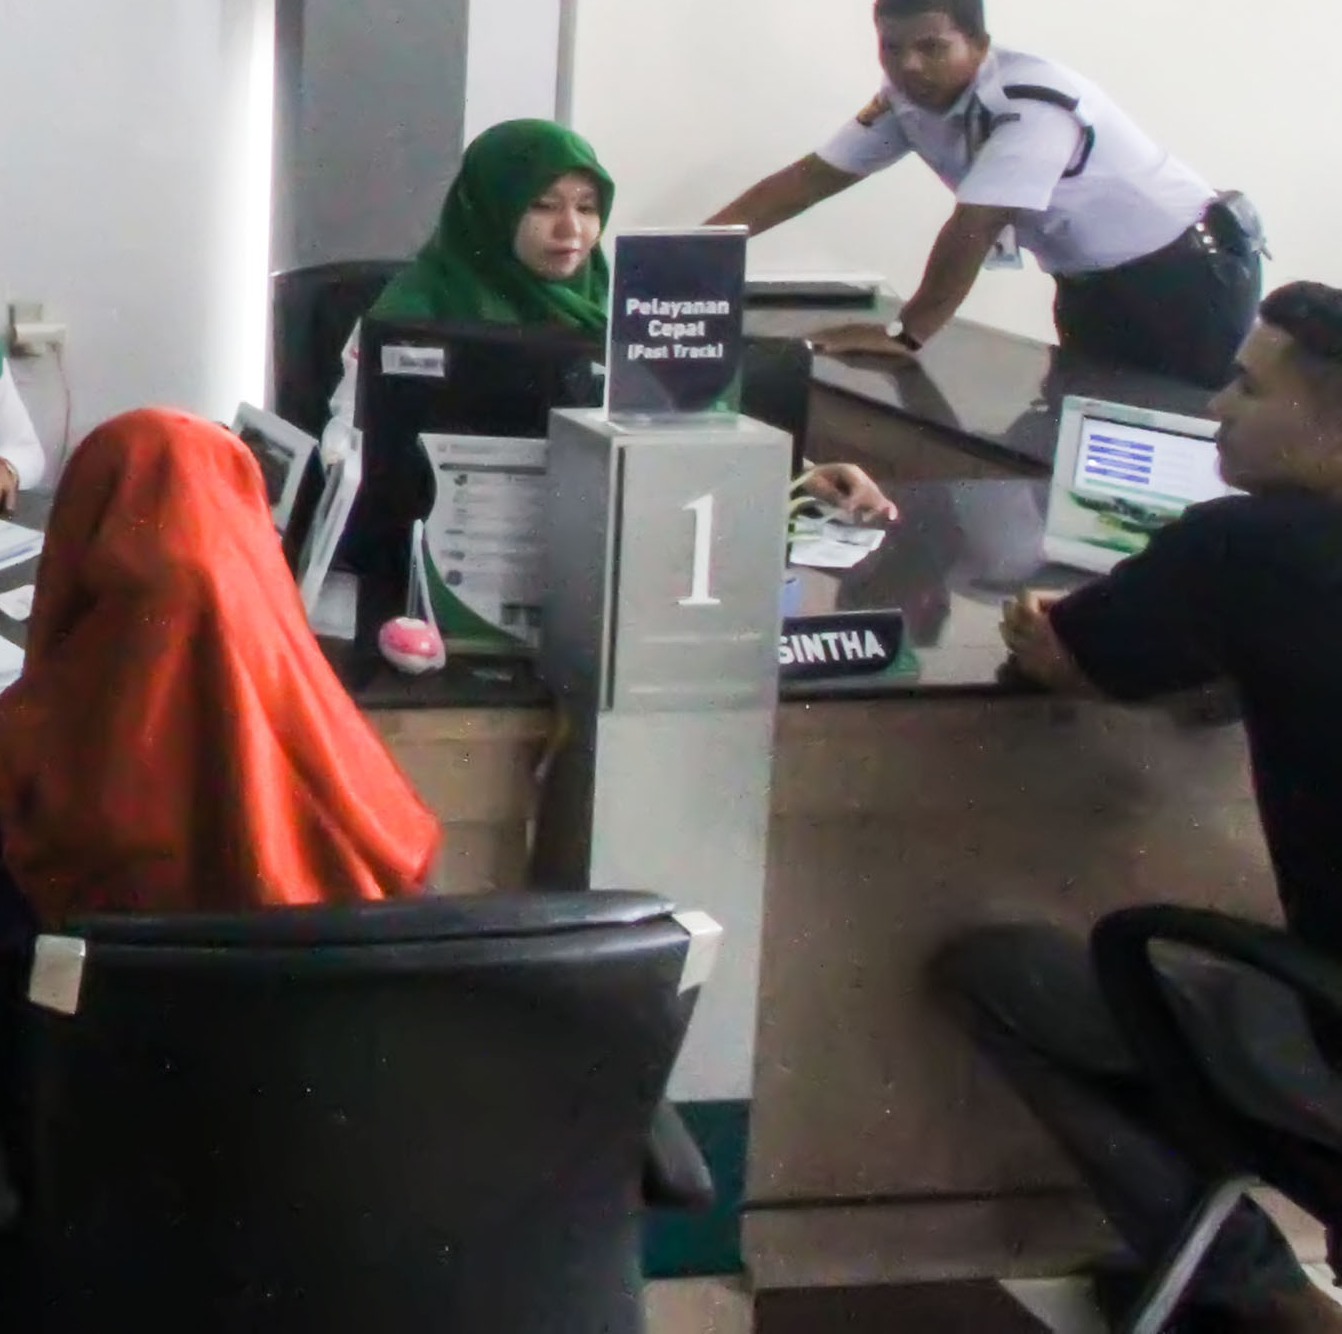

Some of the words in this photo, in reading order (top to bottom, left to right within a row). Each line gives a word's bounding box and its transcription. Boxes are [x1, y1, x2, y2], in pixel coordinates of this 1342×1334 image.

[626, 298, 730, 318] Pelayanan
[648, 320, 706, 339] Cepat
[677, 494, 721, 606] 1
